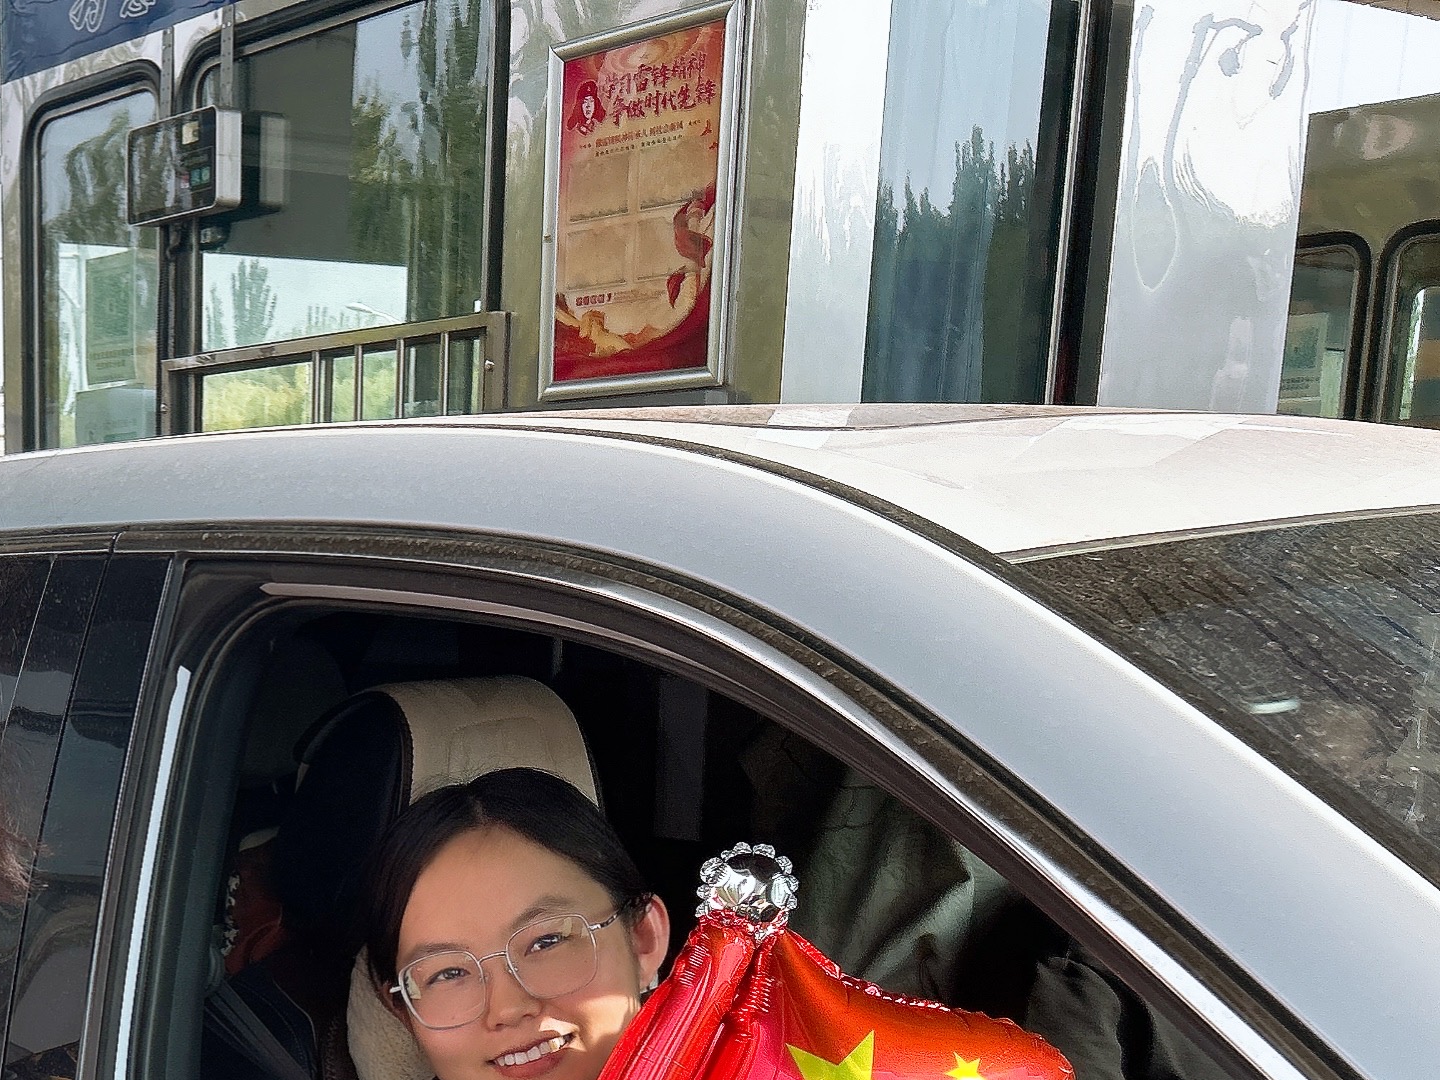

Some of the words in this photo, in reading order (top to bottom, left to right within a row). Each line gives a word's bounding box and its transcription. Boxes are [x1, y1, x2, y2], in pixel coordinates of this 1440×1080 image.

[603, 51, 707, 99] 学习雷锋精神
[610, 75, 716, 126] 争做时代先锋
